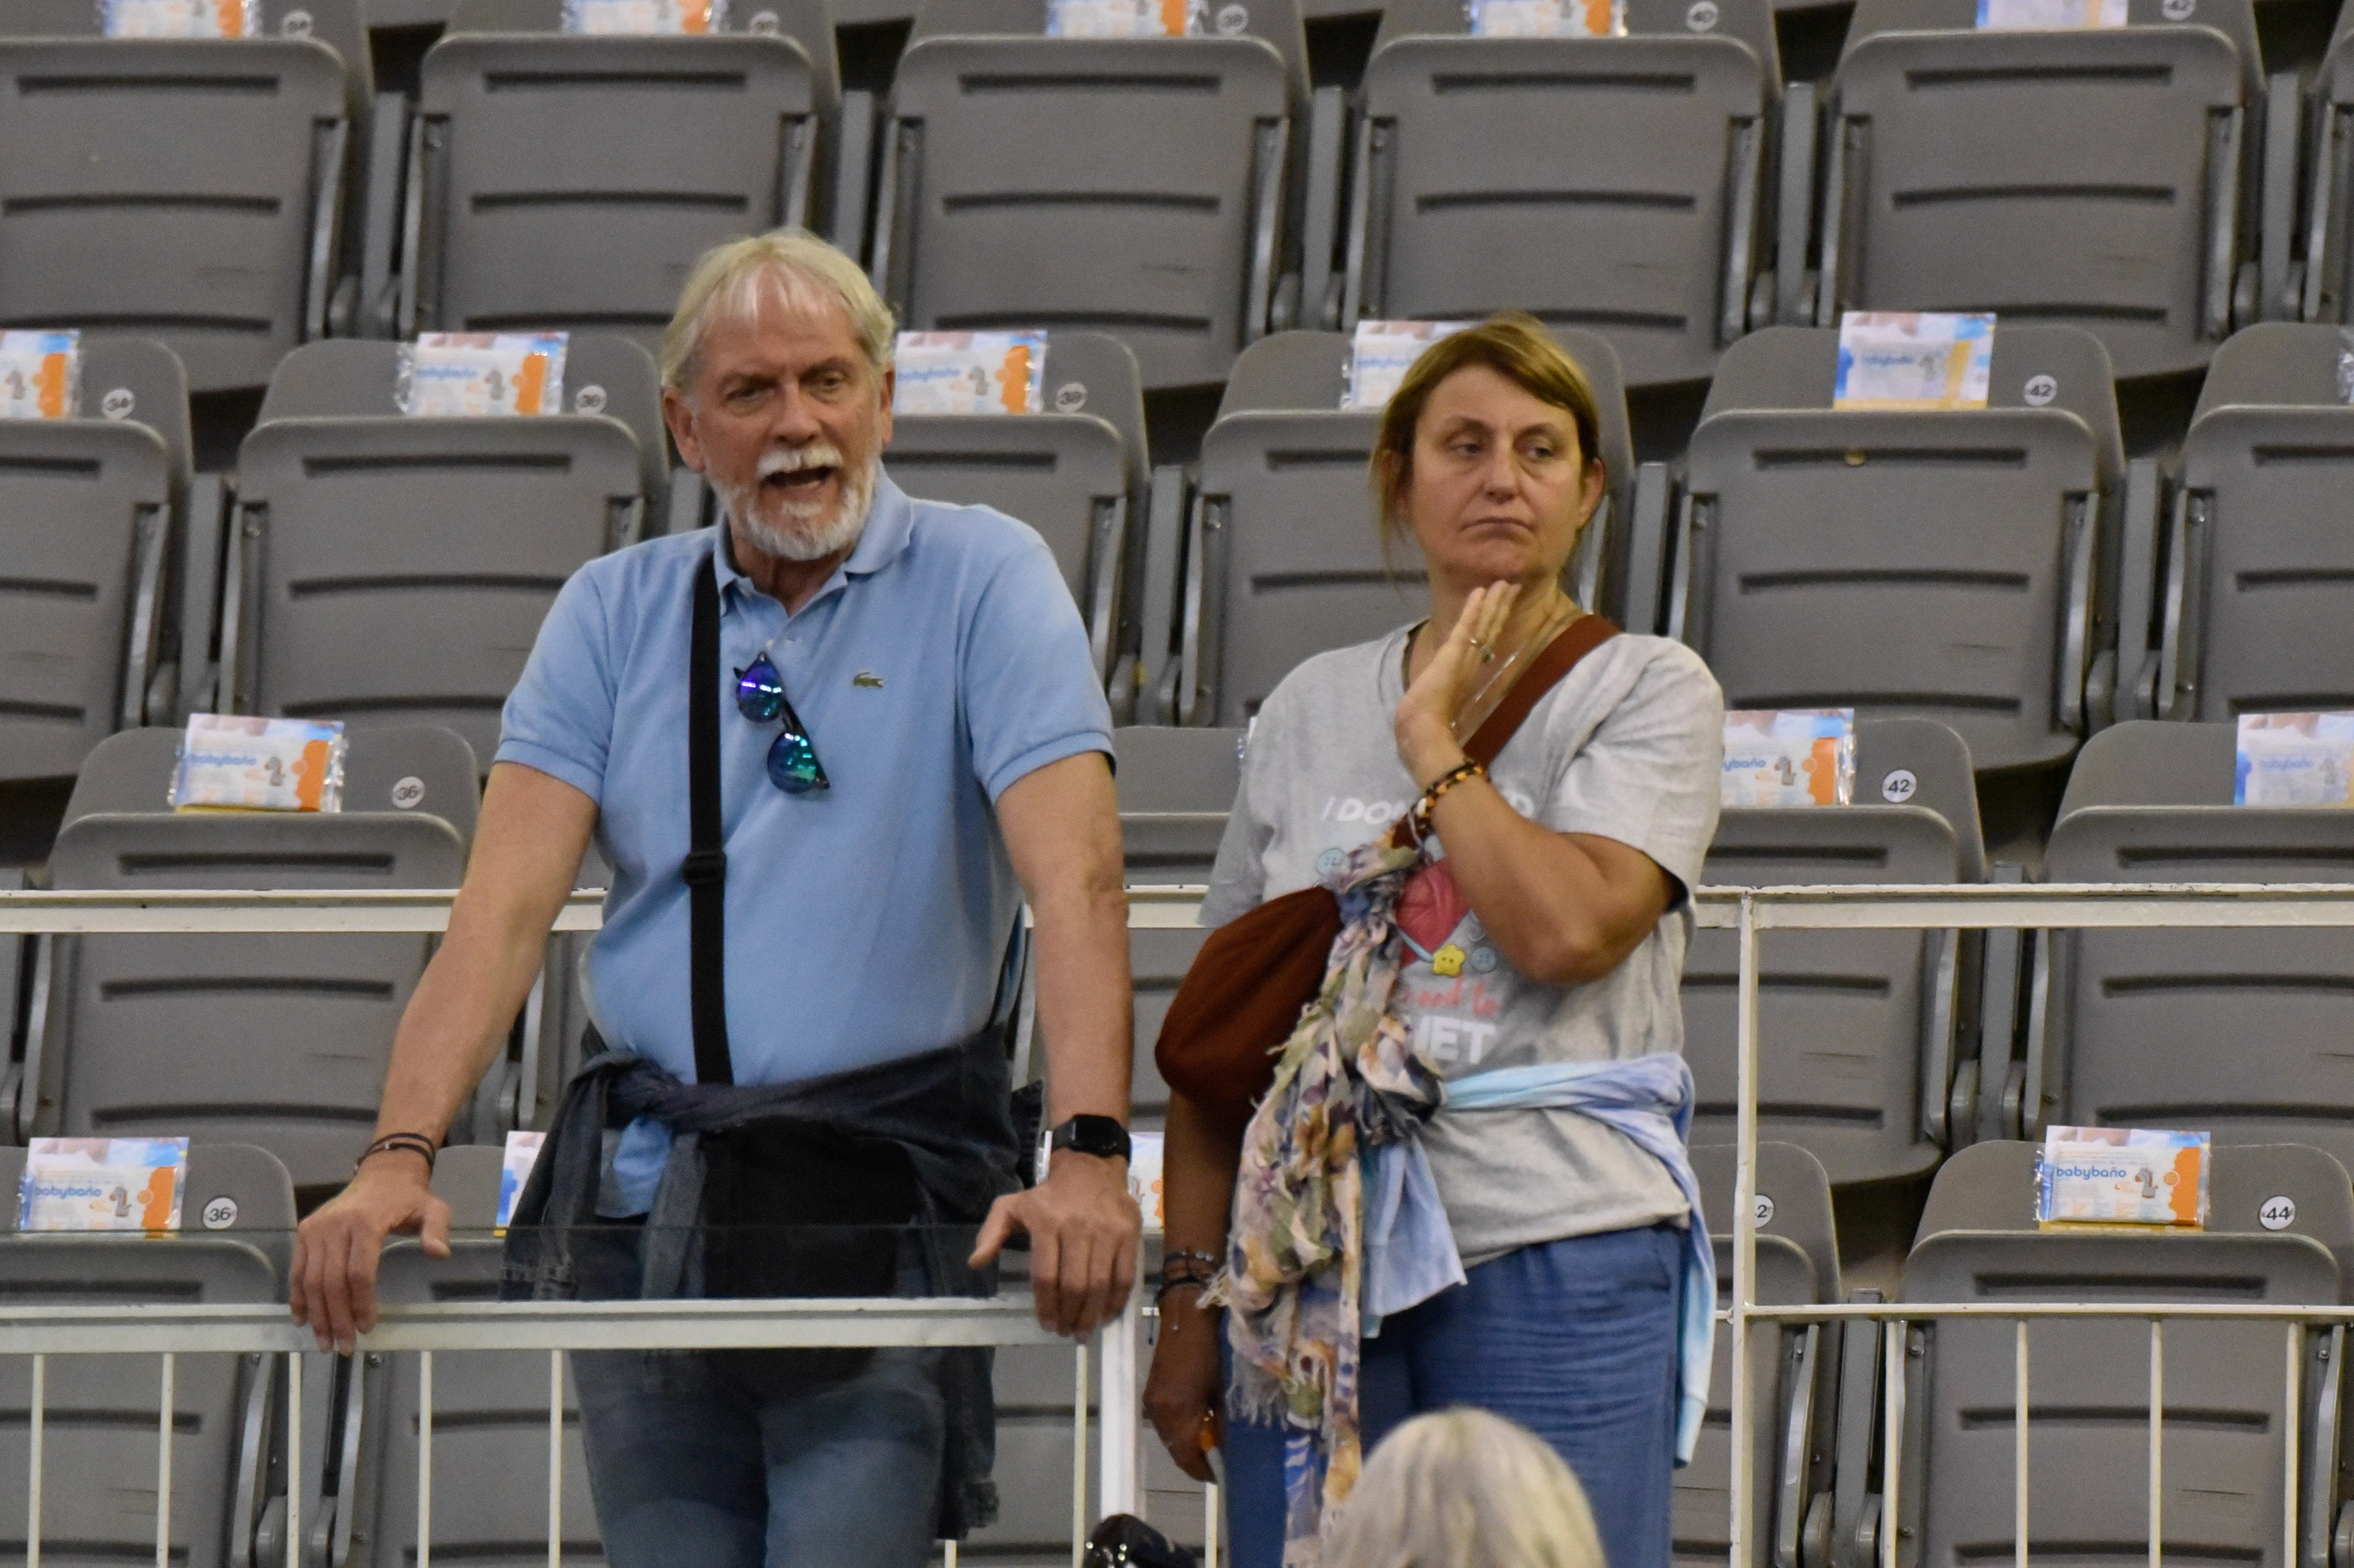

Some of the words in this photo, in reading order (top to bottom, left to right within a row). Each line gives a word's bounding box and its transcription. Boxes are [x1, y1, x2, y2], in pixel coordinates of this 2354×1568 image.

[2030, 384, 2052, 397] 42
[1724, 757, 1767, 772] ybaño
[398, 785, 418, 801] 36
[1887, 778, 1910, 793] 42
[1402, 1015, 1497, 1064] IET
[2056, 1165, 2127, 1180] babybaño
[209, 1206, 231, 1222] 36
[1755, 1204, 1768, 1219] 2
[2266, 1206, 2291, 1221] 44
